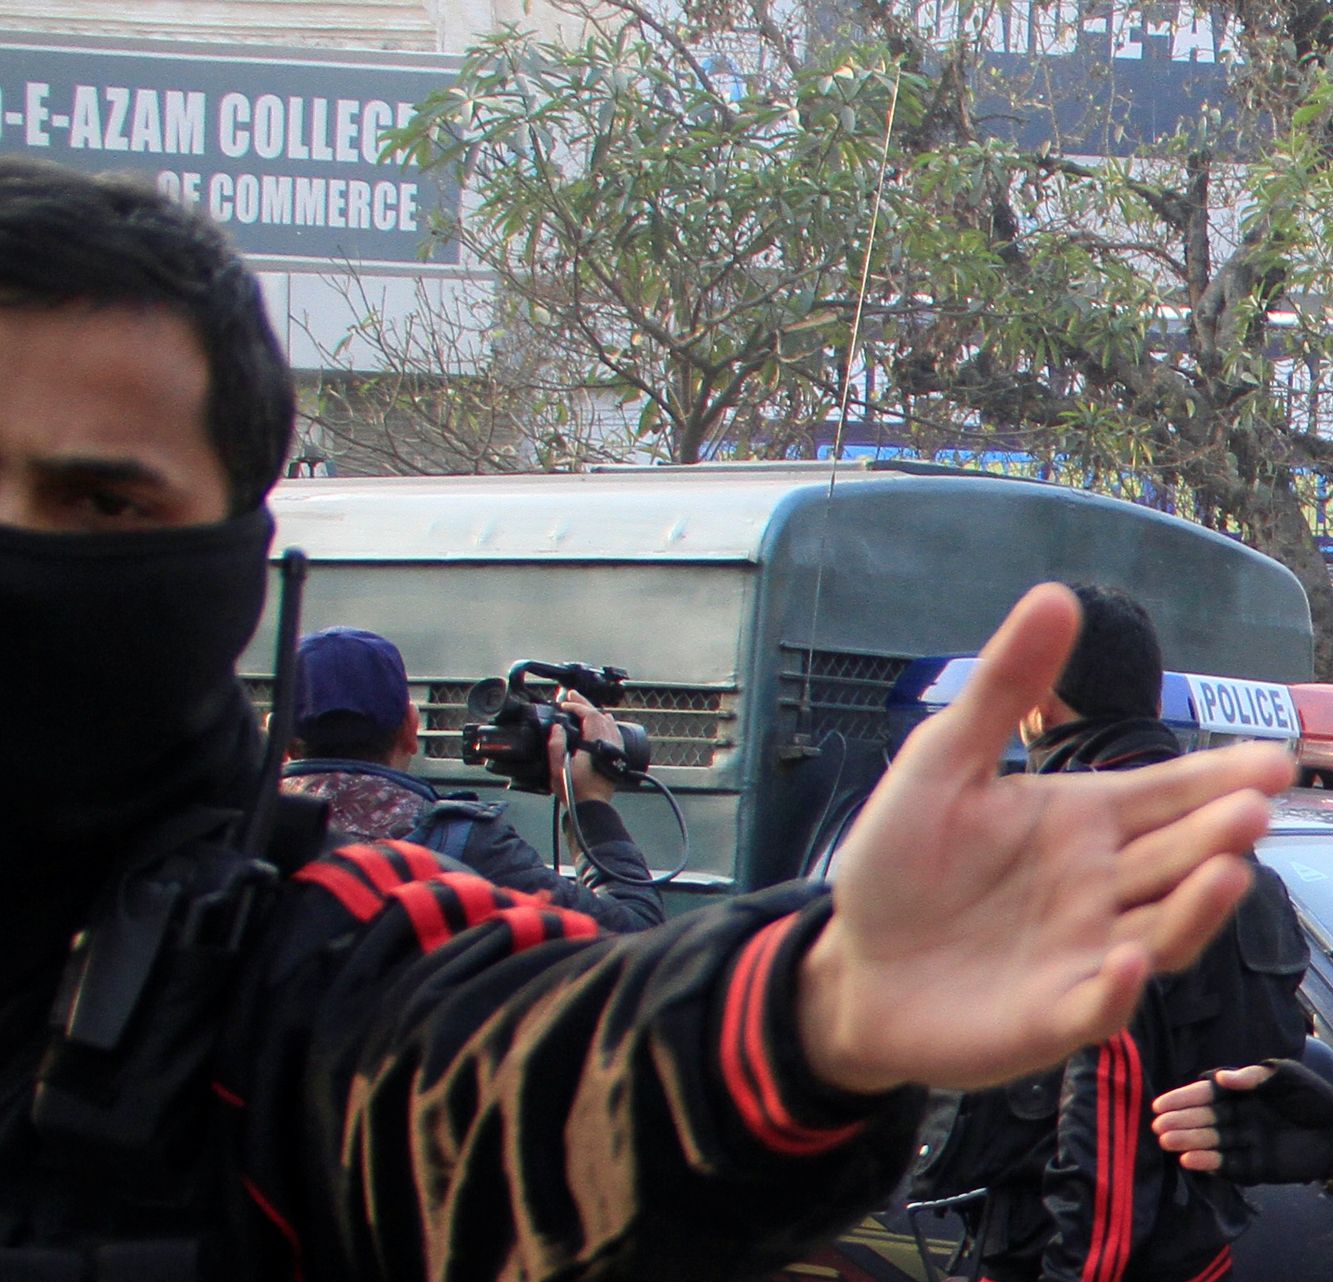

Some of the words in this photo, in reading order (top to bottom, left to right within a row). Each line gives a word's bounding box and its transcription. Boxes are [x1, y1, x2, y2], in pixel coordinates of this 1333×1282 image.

[0, 80, 206, 155] -E-AZAM
[209, 172, 418, 232] COMMERCE
[1200, 682, 1289, 728] POLICE
